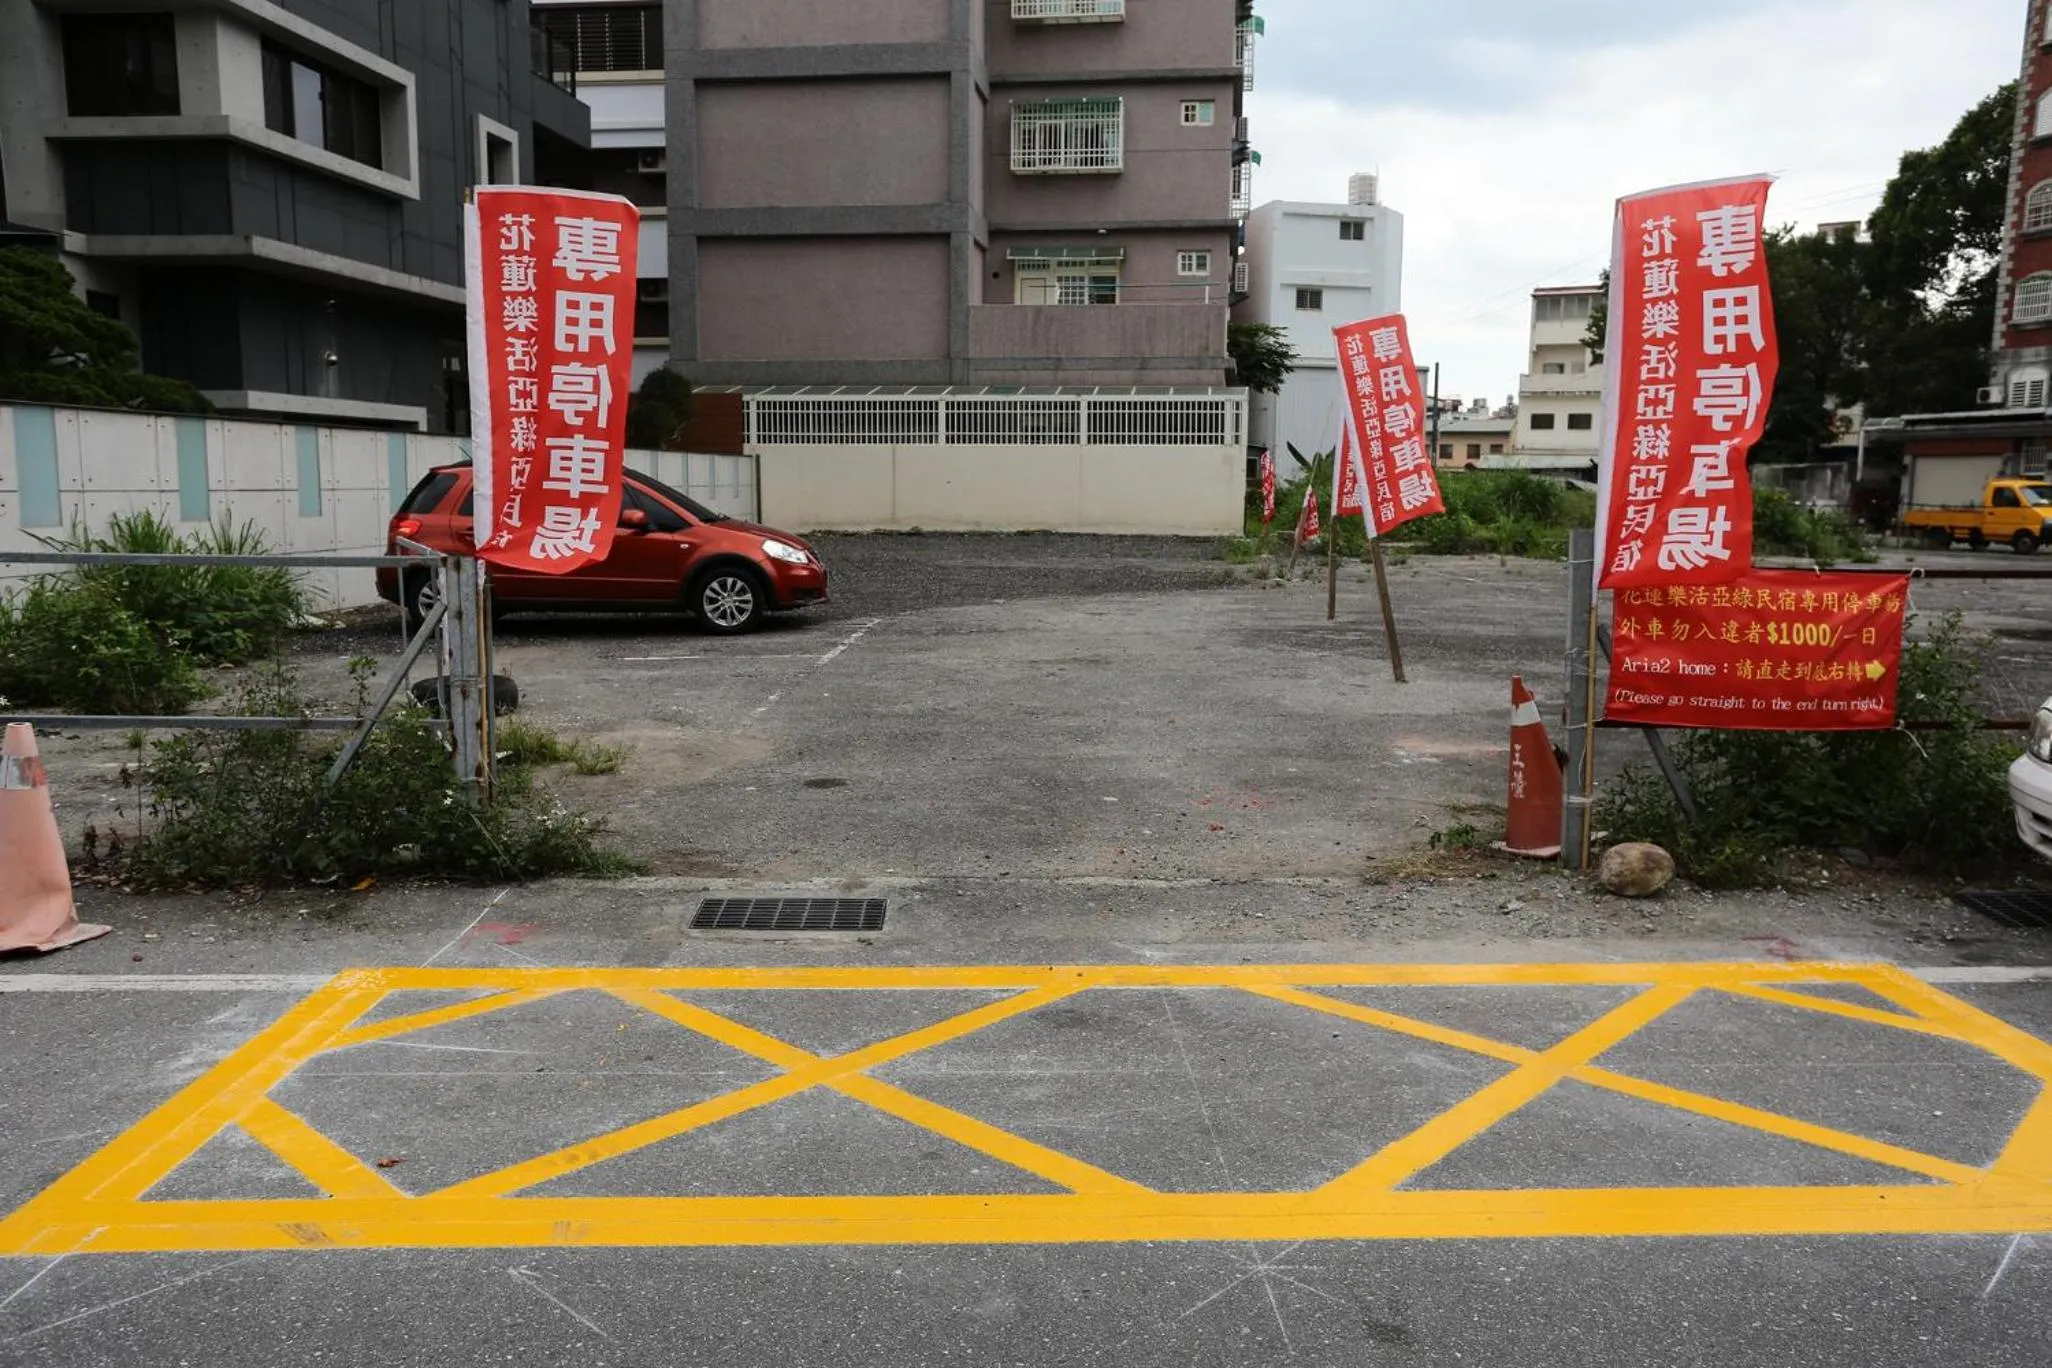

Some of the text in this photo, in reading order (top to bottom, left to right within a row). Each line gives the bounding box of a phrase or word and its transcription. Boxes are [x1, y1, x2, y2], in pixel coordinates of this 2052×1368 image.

[1622, 657, 1671, 674] Aria2
[1614, 688, 1665, 705] (Please
[1667, 696, 1684, 706] go
[1689, 695, 1745, 709] straight
[1752, 697, 1766, 709] to
[1772, 696, 1792, 710] the
[1796, 698, 1818, 711] end
[1822, 699, 1848, 711] turn
